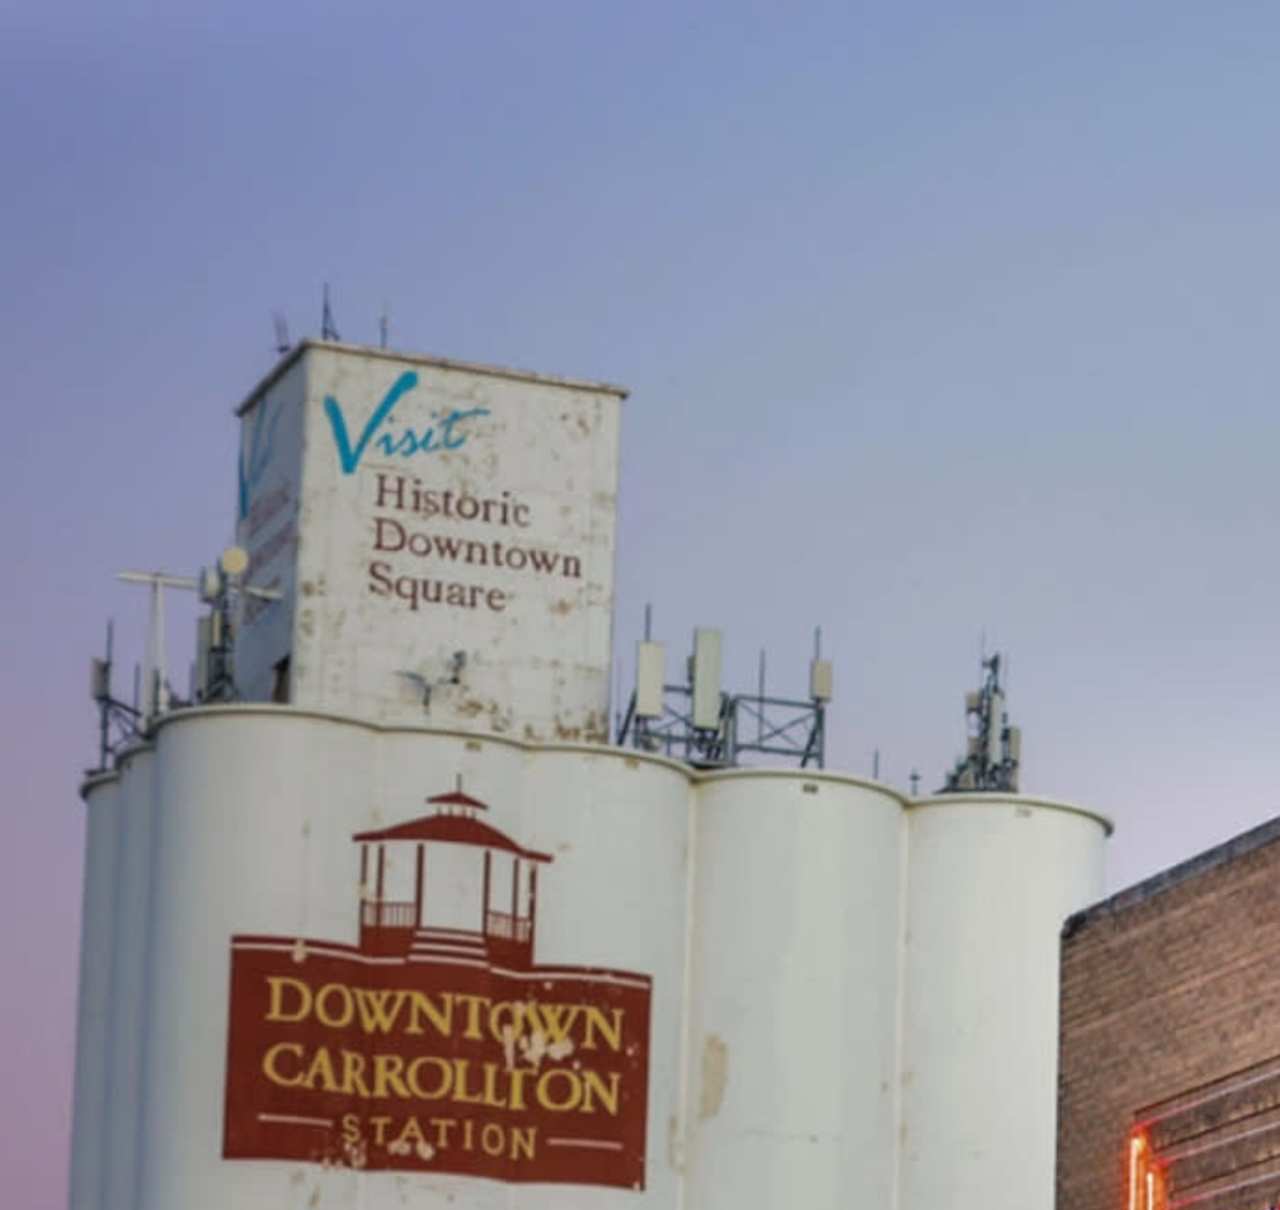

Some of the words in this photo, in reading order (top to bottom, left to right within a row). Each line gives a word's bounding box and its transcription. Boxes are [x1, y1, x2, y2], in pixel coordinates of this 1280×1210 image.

[324, 371, 490, 474] Visit
[375, 474, 532, 528] Historic
[372, 518, 583, 579] Downtown
[368, 561, 508, 612] Square
[266, 976, 623, 1050] DOWNTOWN
[263, 1042, 620, 1114] CARROLLTON
[343, 1115, 537, 1160] STATION
